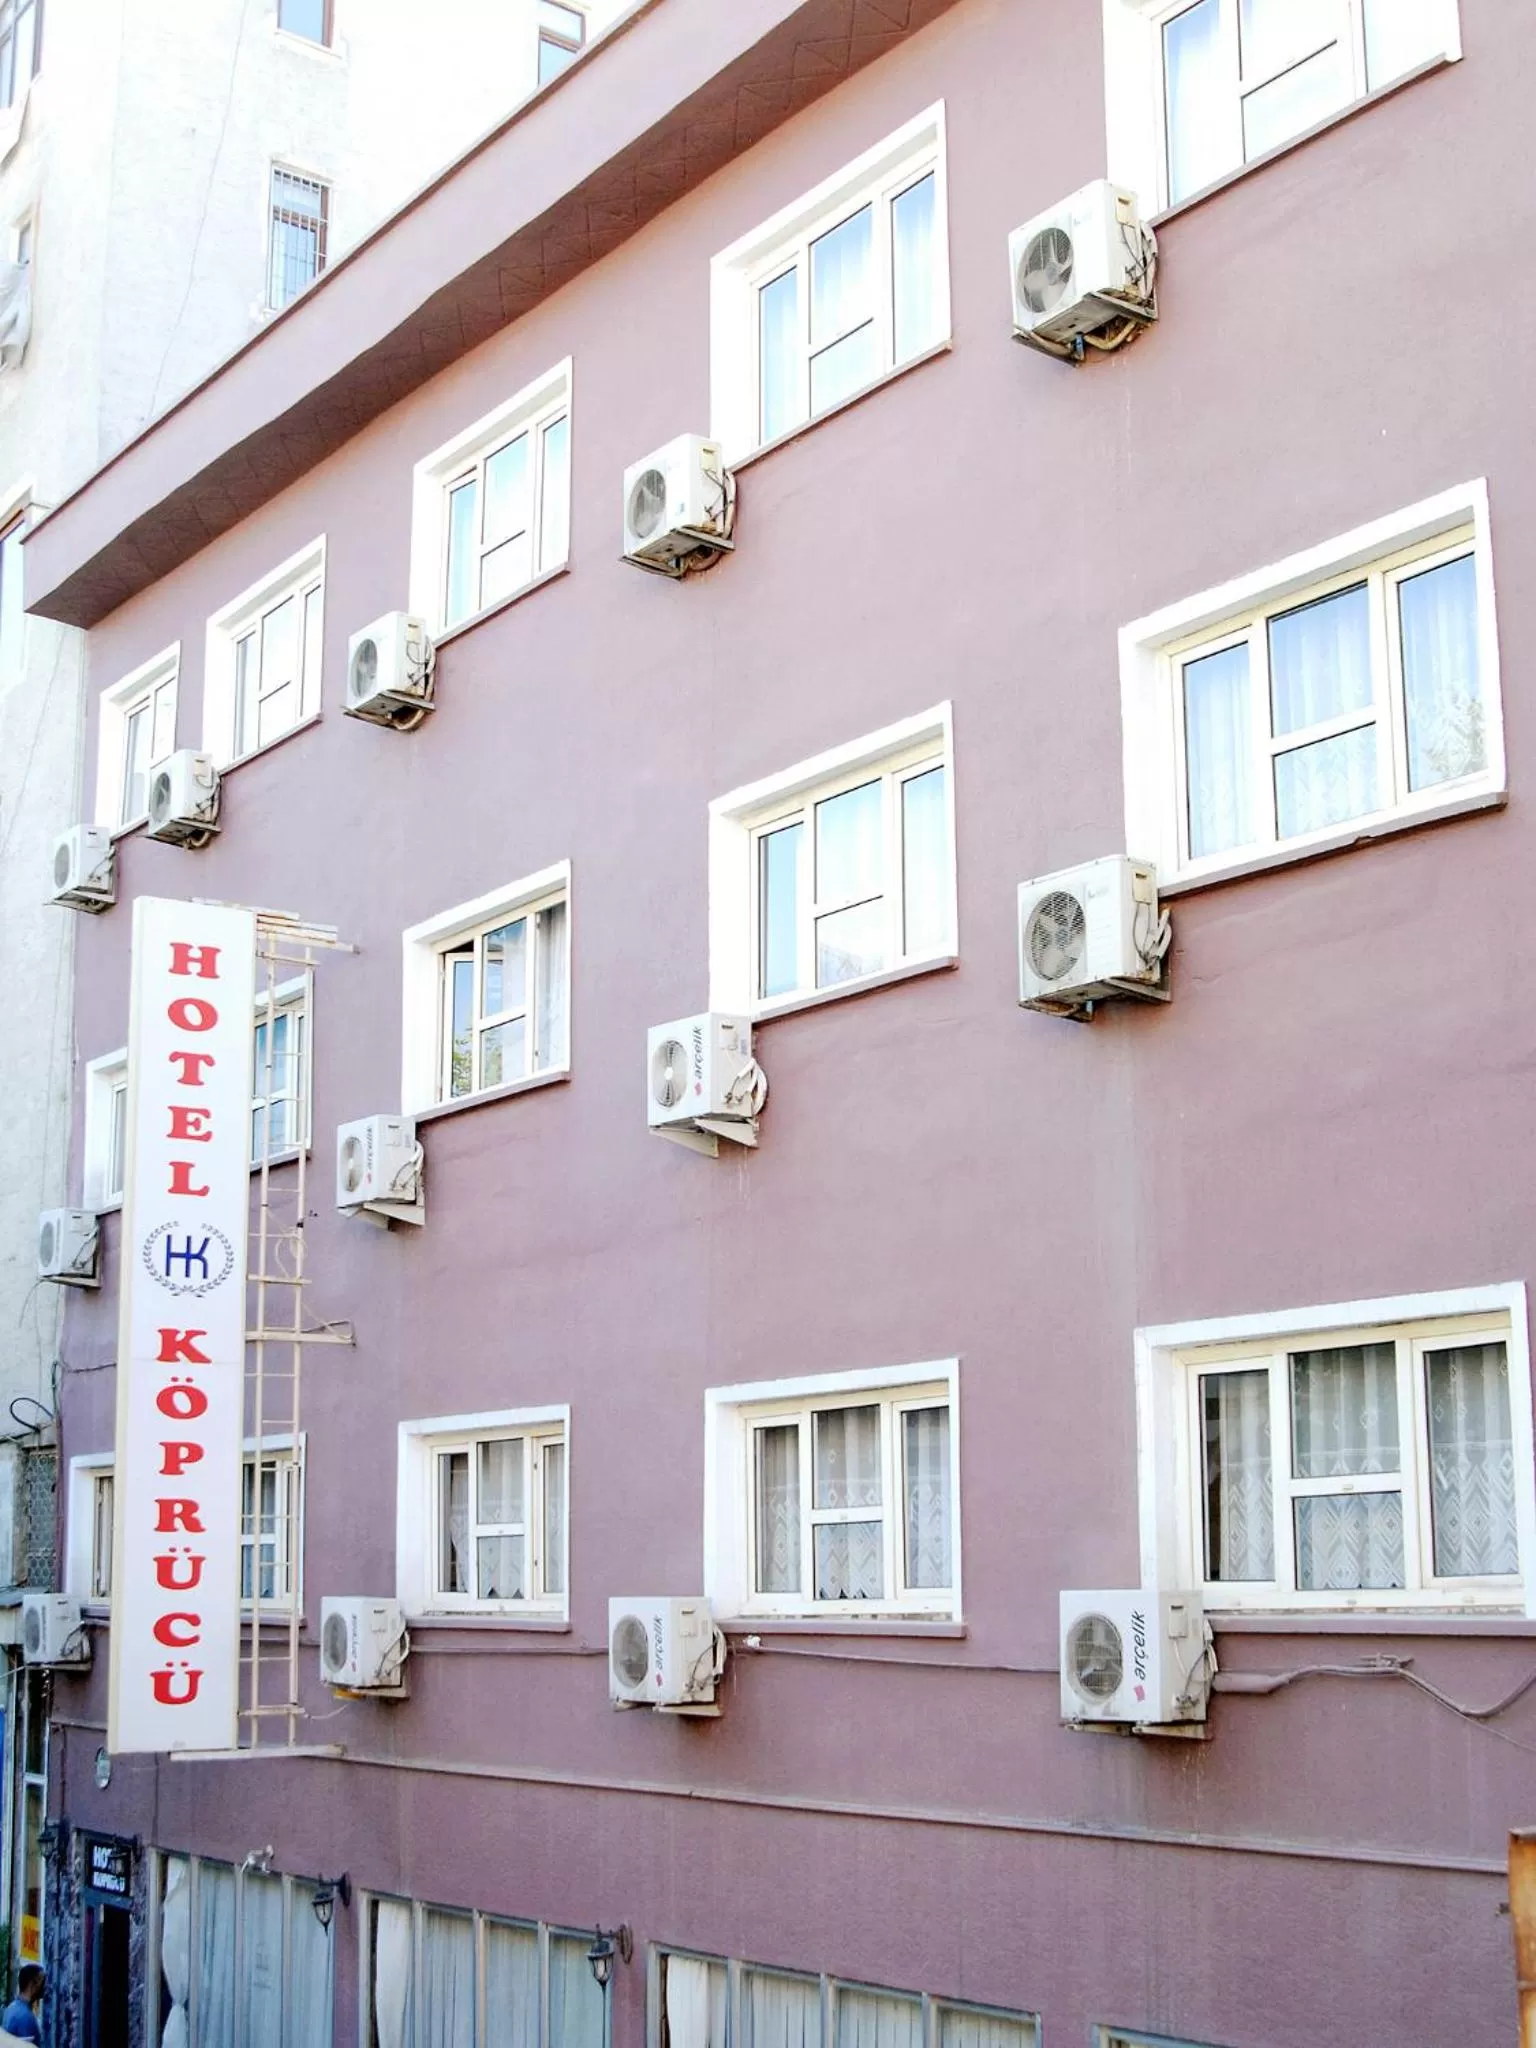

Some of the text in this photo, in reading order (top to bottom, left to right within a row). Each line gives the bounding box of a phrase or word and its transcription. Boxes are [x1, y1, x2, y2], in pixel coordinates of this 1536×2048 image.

[166, 943, 221, 1197] HOTEL
[165, 1235, 210, 1279] HK
[150, 1328, 212, 1704] KÖPRÜCÜ
